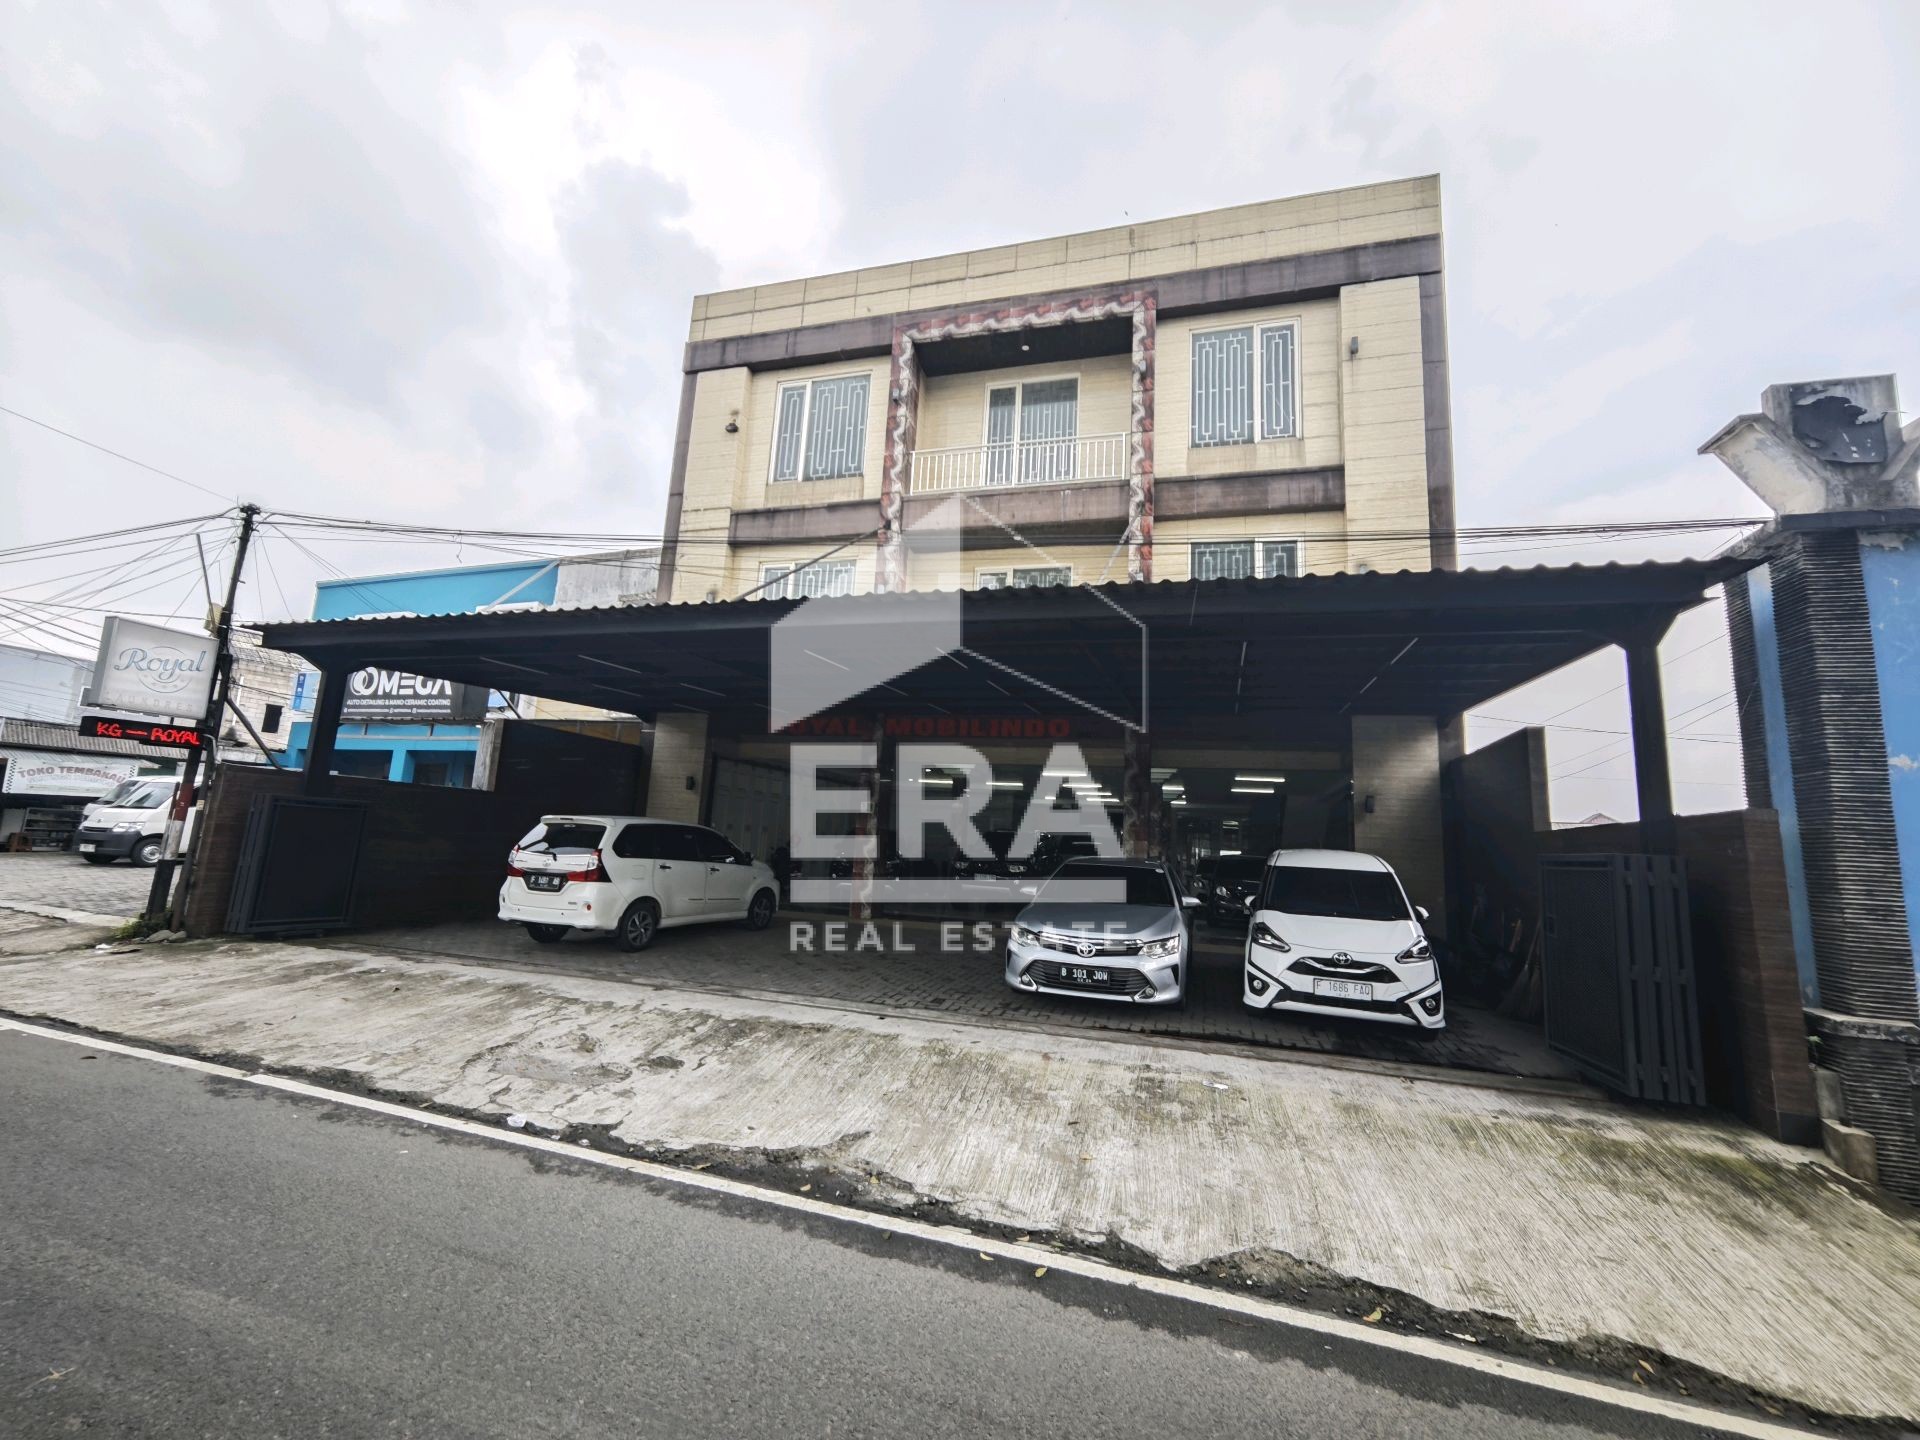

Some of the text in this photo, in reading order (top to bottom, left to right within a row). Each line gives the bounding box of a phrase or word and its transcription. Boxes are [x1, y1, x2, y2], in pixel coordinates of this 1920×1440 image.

[113, 648, 208, 680] Royal
[96, 721, 123, 737] KG
[151, 727, 200, 745] ROYAL
[884, 718, 1071, 738] MOBILINDO
[18, 766, 55, 779] TOKO
[57, 766, 128, 784] TEMBAKAU
[1072, 968, 1087, 979] 101
[1316, 980, 1321, 990] F
